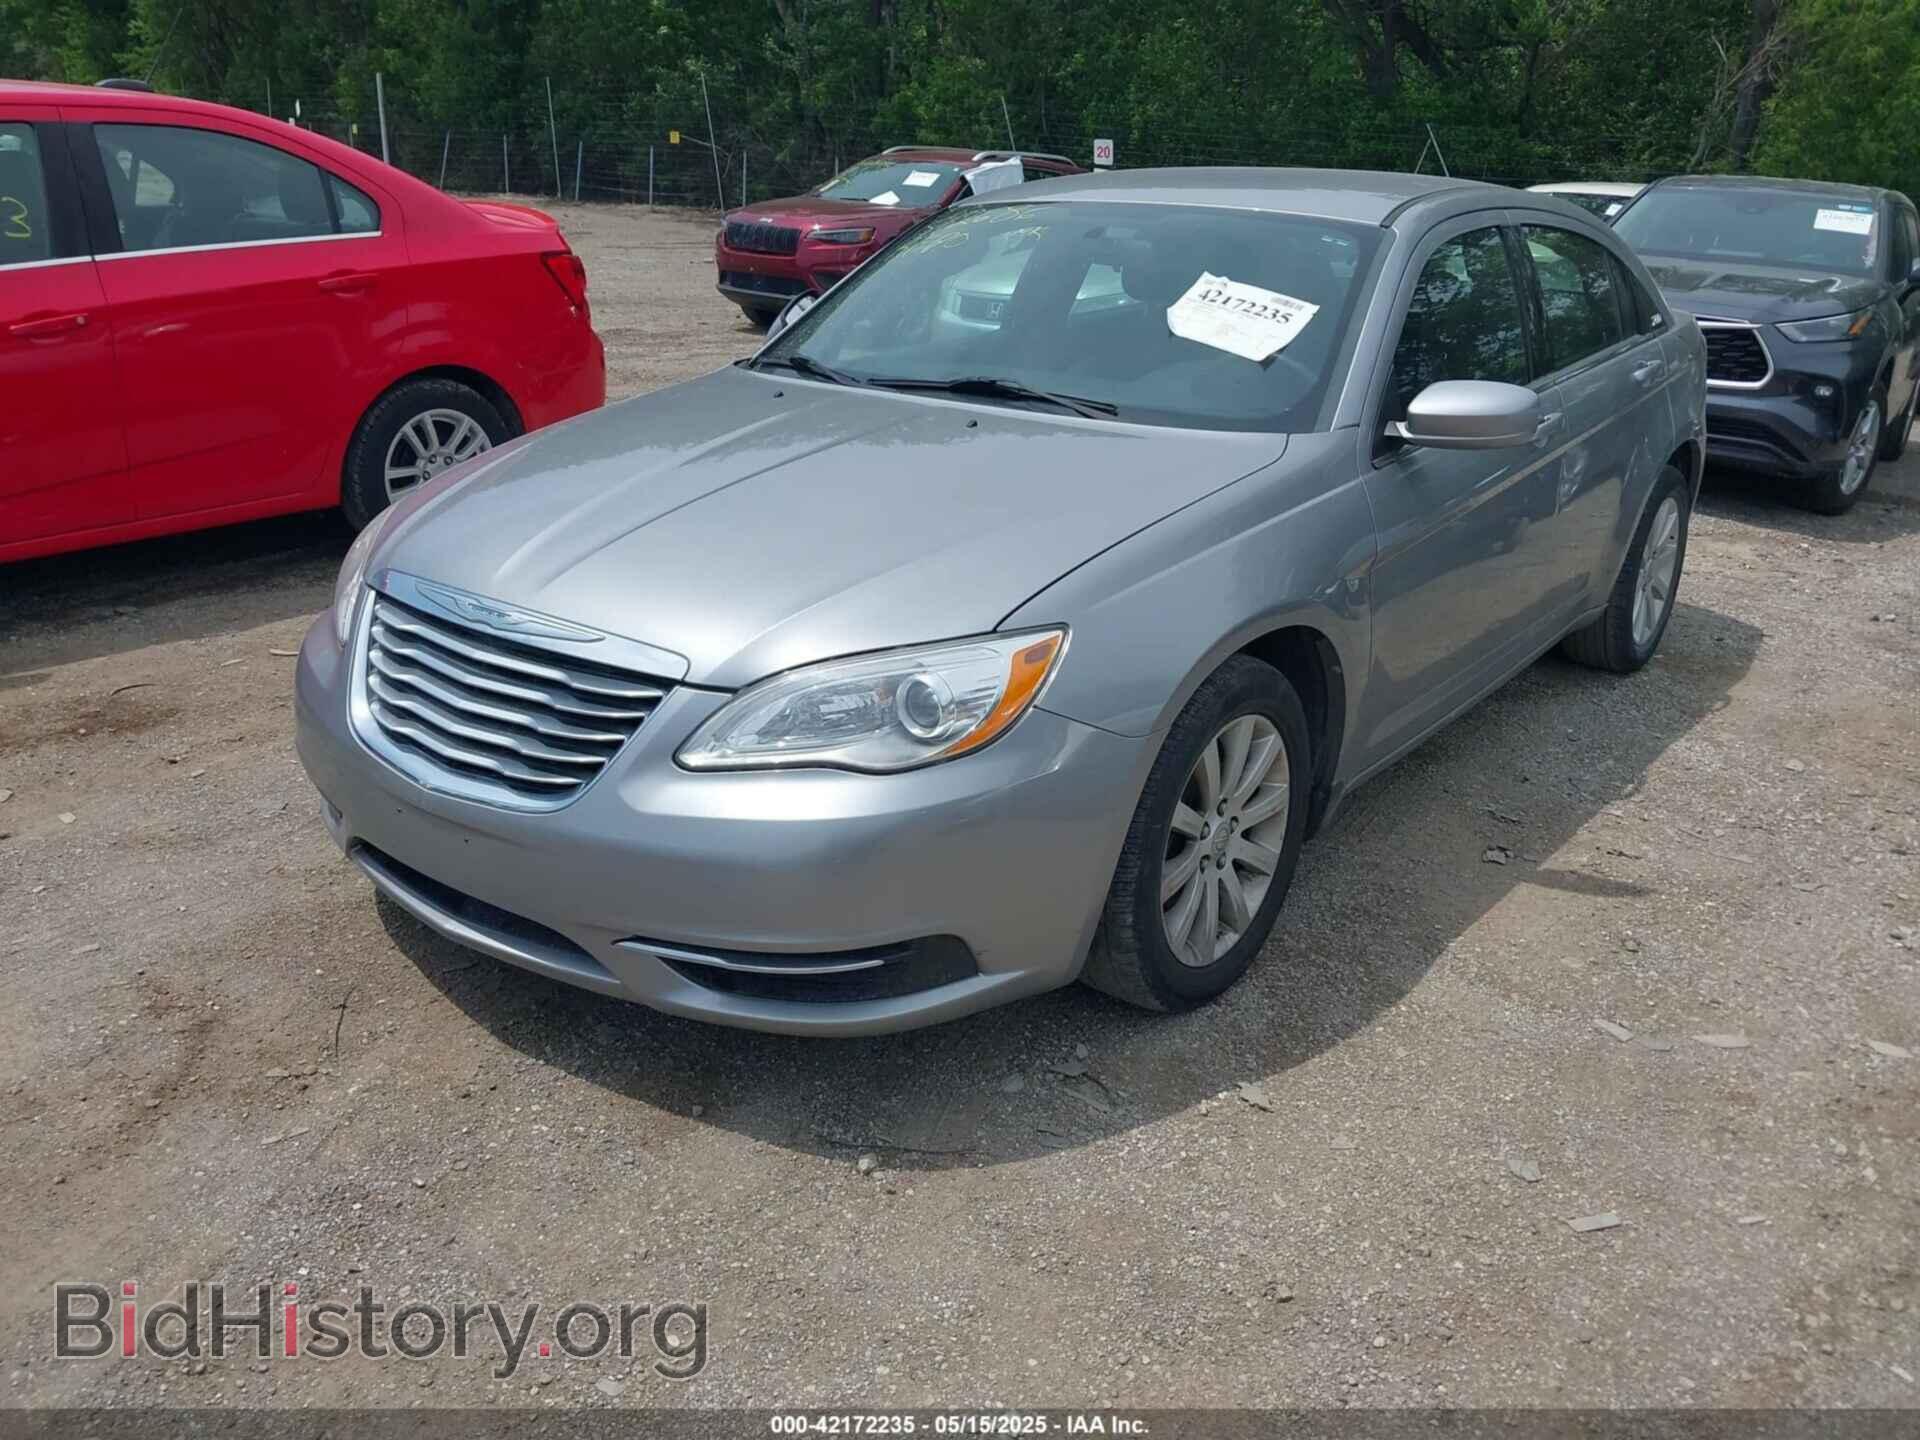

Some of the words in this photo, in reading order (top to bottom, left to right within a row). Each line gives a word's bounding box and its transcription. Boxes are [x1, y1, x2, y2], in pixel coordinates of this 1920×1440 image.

[1096, 145, 1111, 159] 20
[1, 196, 32, 238] 3
[1198, 288, 1293, 325] 42172235
